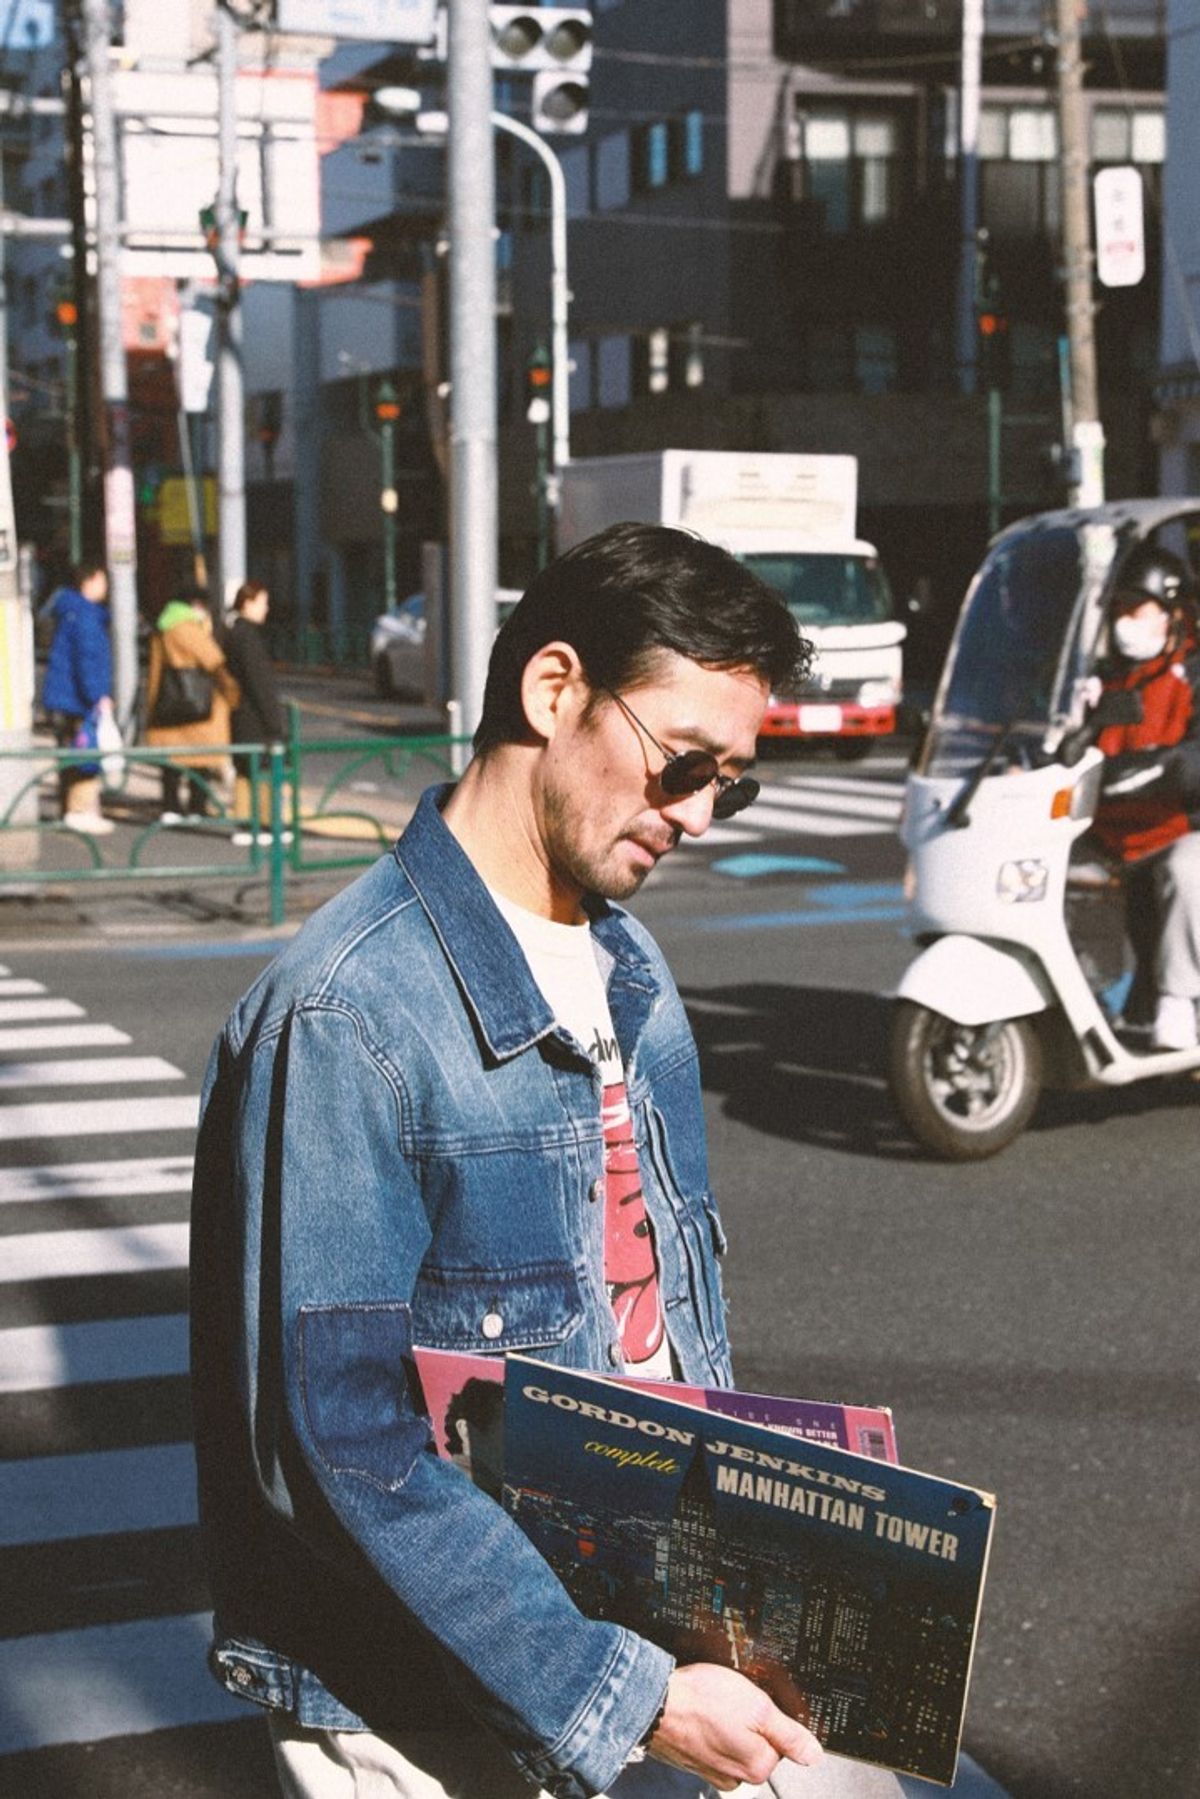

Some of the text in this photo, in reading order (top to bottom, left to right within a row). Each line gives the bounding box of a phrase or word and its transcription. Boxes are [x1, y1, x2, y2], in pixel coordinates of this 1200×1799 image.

[522, 1385, 886, 1502] GORDON JENKINS
[584, 1441, 680, 1475] complete
[805, 1428, 838, 1440] BETTER
[716, 1465, 960, 1562] MANHATTAN TOWER
